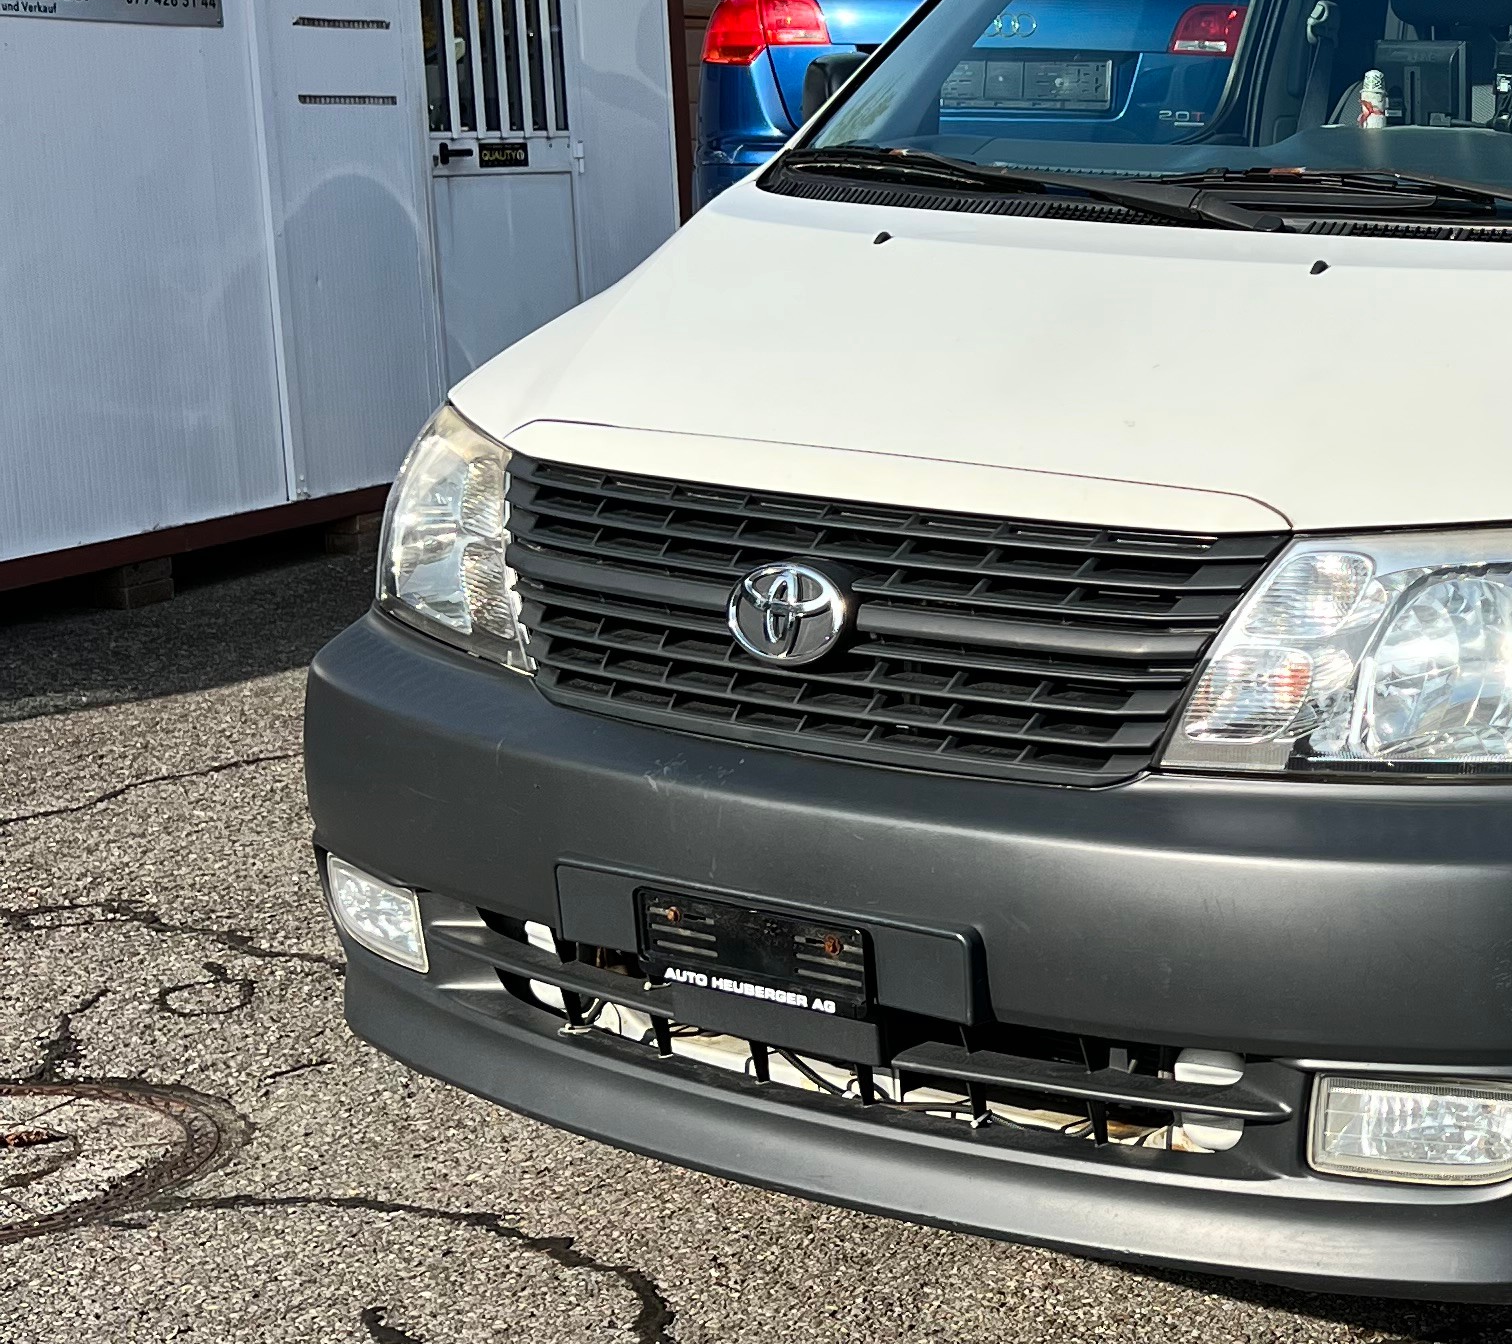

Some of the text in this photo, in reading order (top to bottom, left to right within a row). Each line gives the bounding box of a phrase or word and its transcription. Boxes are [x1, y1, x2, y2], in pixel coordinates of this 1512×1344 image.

[2, 1, 57, 13] und Verkauf
[664, 967, 837, 1014] AUTO HEUBERGER AG
